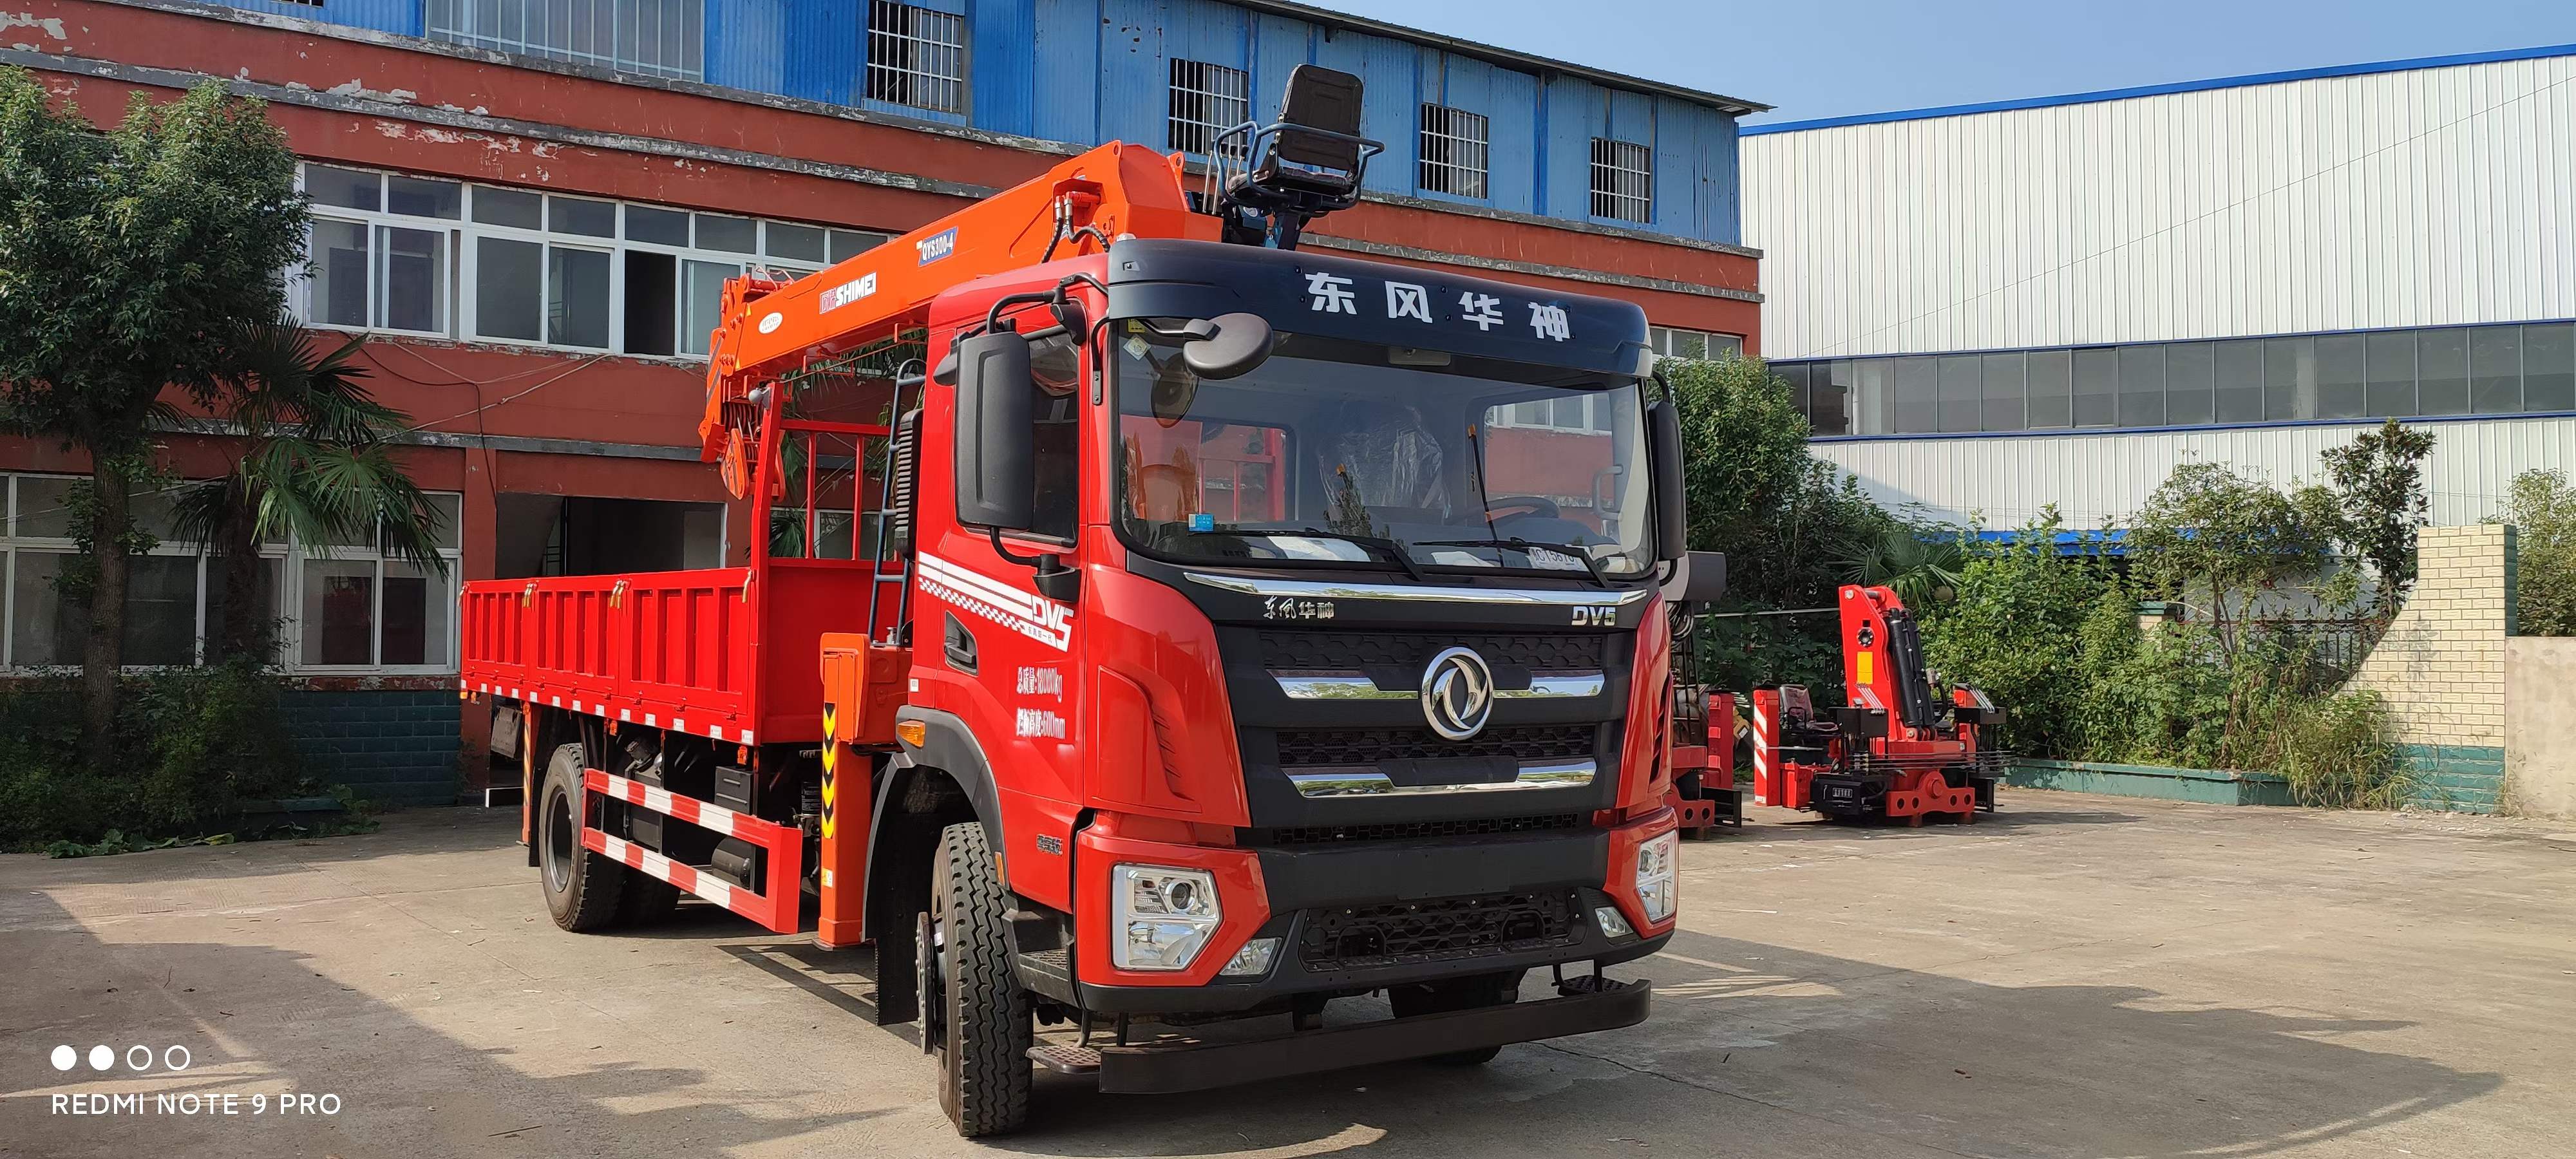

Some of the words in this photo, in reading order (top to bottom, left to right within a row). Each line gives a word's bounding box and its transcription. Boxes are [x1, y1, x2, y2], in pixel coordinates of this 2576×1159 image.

[922, 232, 954, 261] QYS300-4
[836, 272, 876, 307] SHIMEI
[1305, 272, 1571, 342] 东风华神
[1263, 596, 1334, 619] 东风华神
[1571, 606, 1616, 626] DV5
[1032, 595, 1074, 653] DV5
